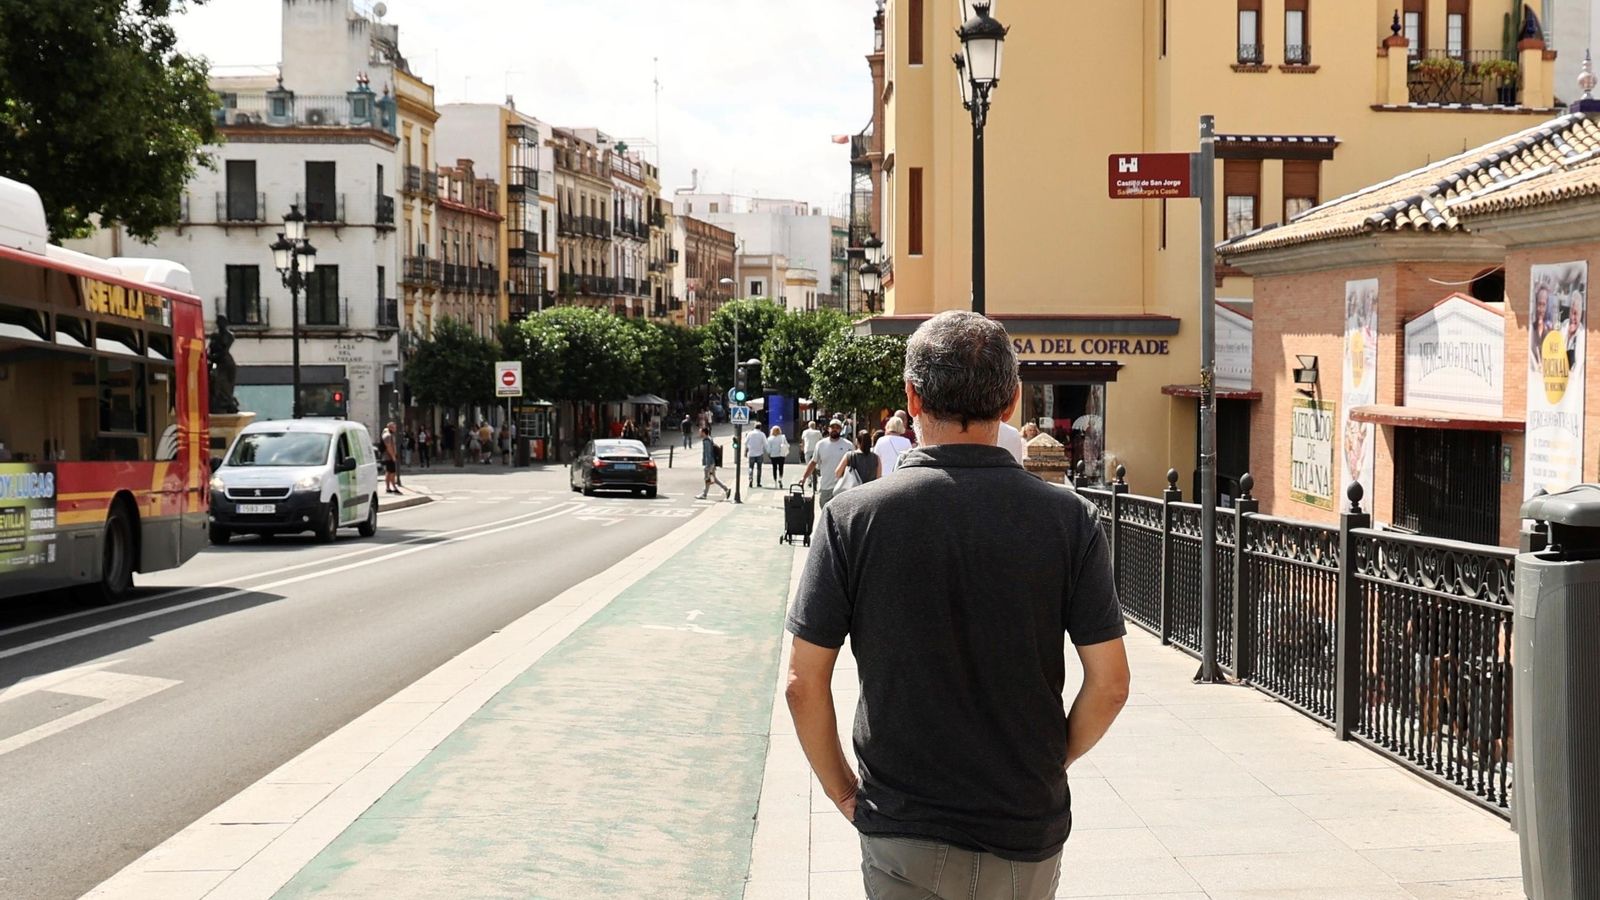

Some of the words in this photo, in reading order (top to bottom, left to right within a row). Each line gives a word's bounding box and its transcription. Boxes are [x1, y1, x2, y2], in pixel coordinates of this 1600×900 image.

[1141, 179, 1149, 187] de
[1150, 179, 1162, 187] San
[1163, 180, 1181, 188] Jorge
[1040, 339, 1076, 354] DEL
[1081, 339, 1169, 355] COFRADE
[1294, 410, 1332, 442] MERCADO
[1307, 443, 1316, 460] DE
[16, 471, 54, 498] LUCAS
[1293, 459, 1332, 497] TRIANA
